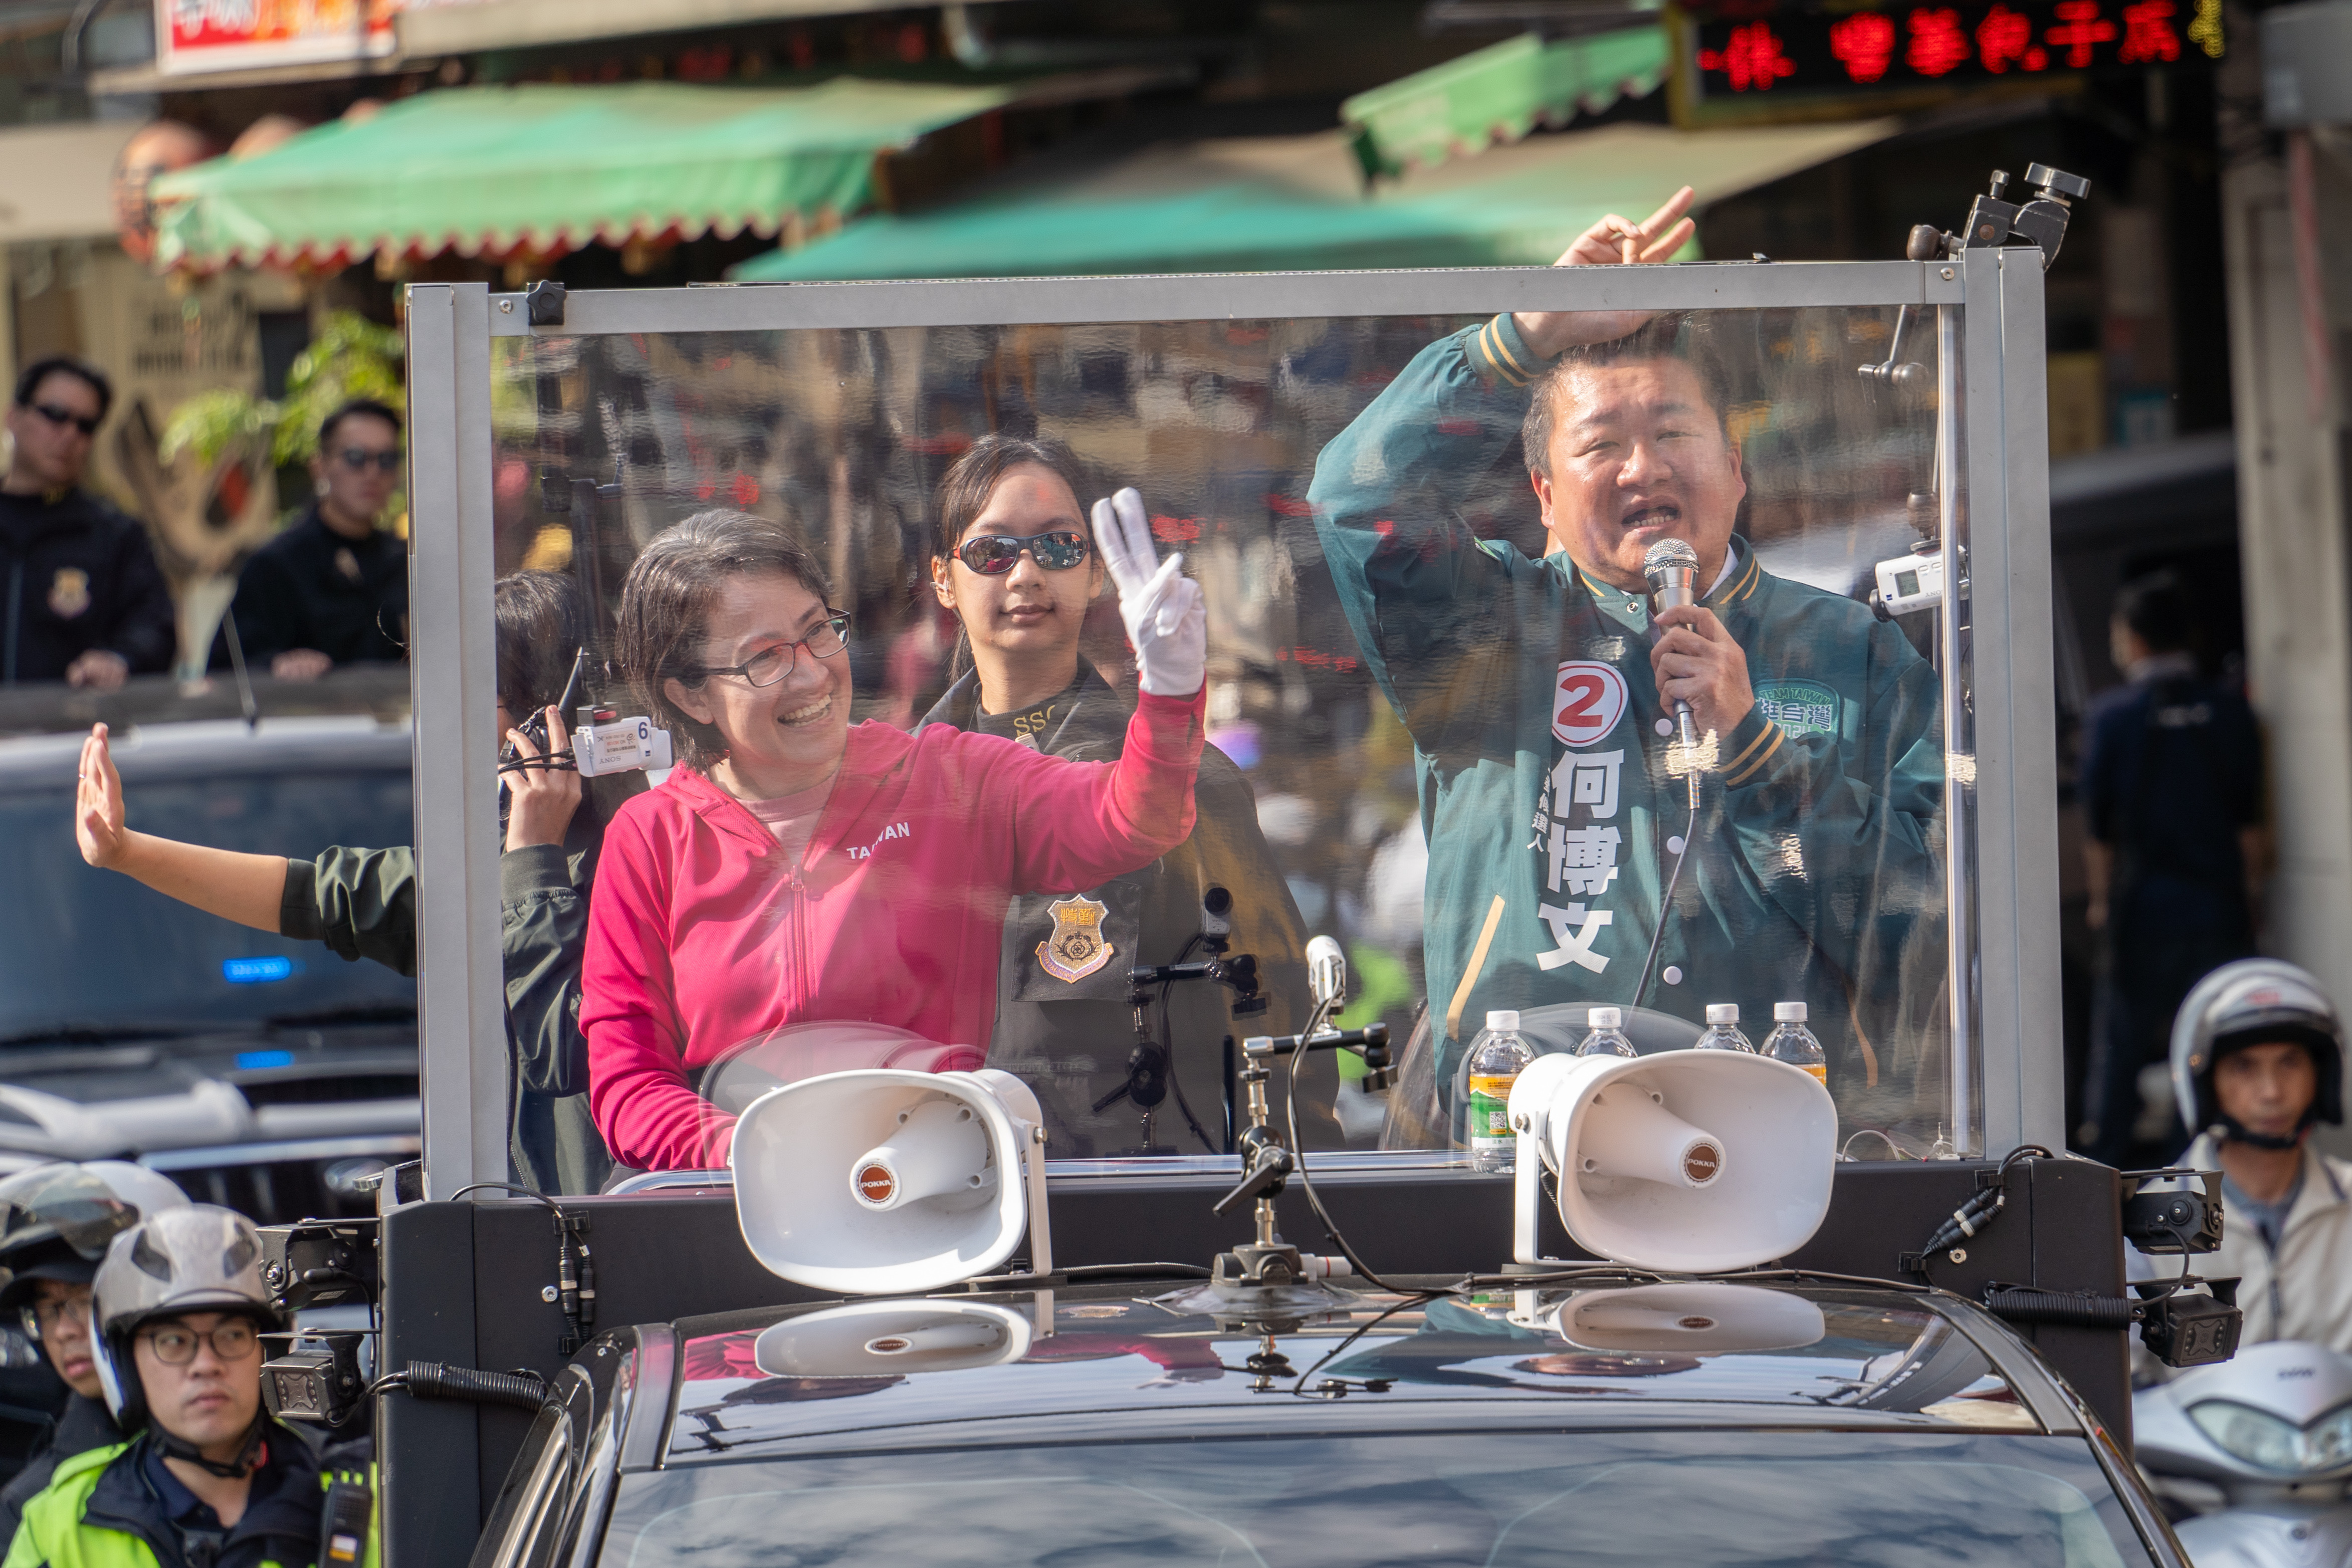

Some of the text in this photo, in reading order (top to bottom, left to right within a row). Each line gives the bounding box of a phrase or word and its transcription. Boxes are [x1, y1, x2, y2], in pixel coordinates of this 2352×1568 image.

[1557, 675, 1605, 727] 2
[1759, 688, 1830, 704] TEAM TAIWAN
[599, 756, 621, 764] SONY
[1536, 749, 1624, 974] 何博文
[1687, 1158, 1715, 1168] POKKA
[861, 1180, 892, 1189] POKKA
